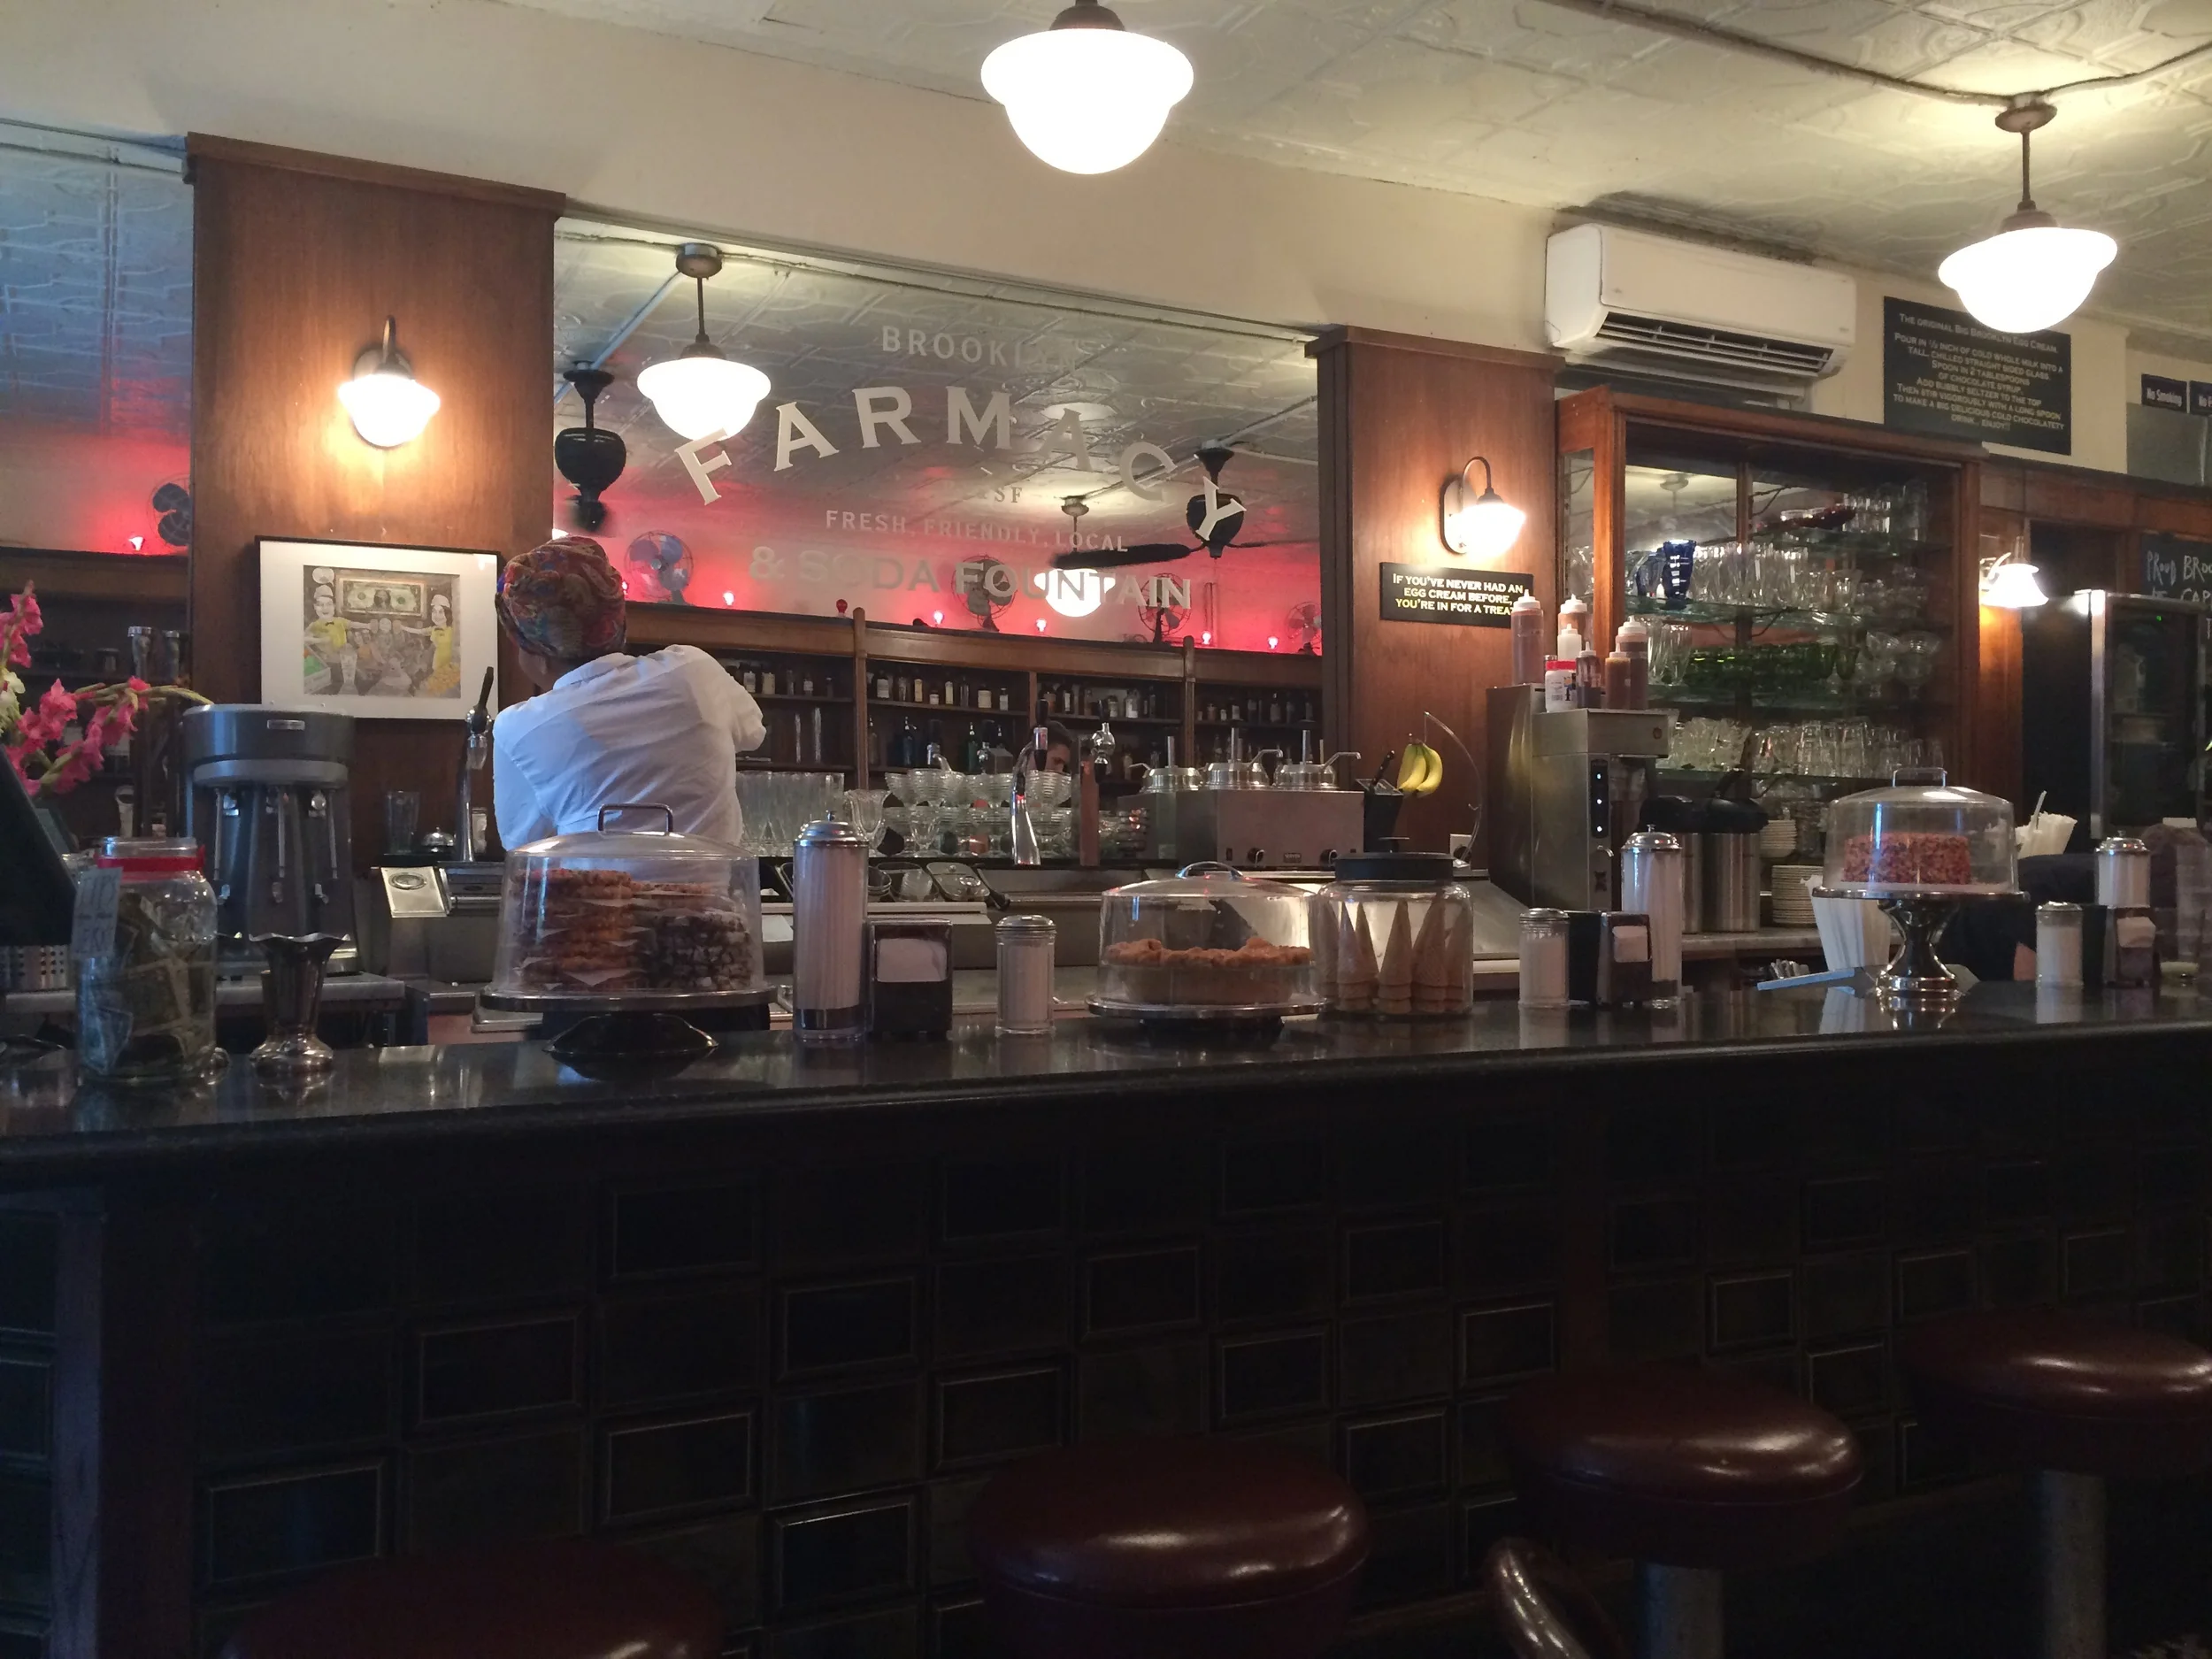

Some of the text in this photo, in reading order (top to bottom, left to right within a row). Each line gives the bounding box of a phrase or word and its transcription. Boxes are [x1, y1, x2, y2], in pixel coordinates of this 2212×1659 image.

[674, 386, 1247, 541] FARMACY
[1056, 530, 1128, 552] LOCAL
[749, 546, 1192, 610] & SODA FOUNTAIN
[1393, 573, 1524, 594] IF YOU'VE NEVER HAD AN
[1395, 599, 1435, 611] YOU'RE
[1437, 602, 1448, 611] IN
[1450, 603, 1472, 613] FOR
[1404, 588, 1513, 605] EGG CREAM BEFORE,
